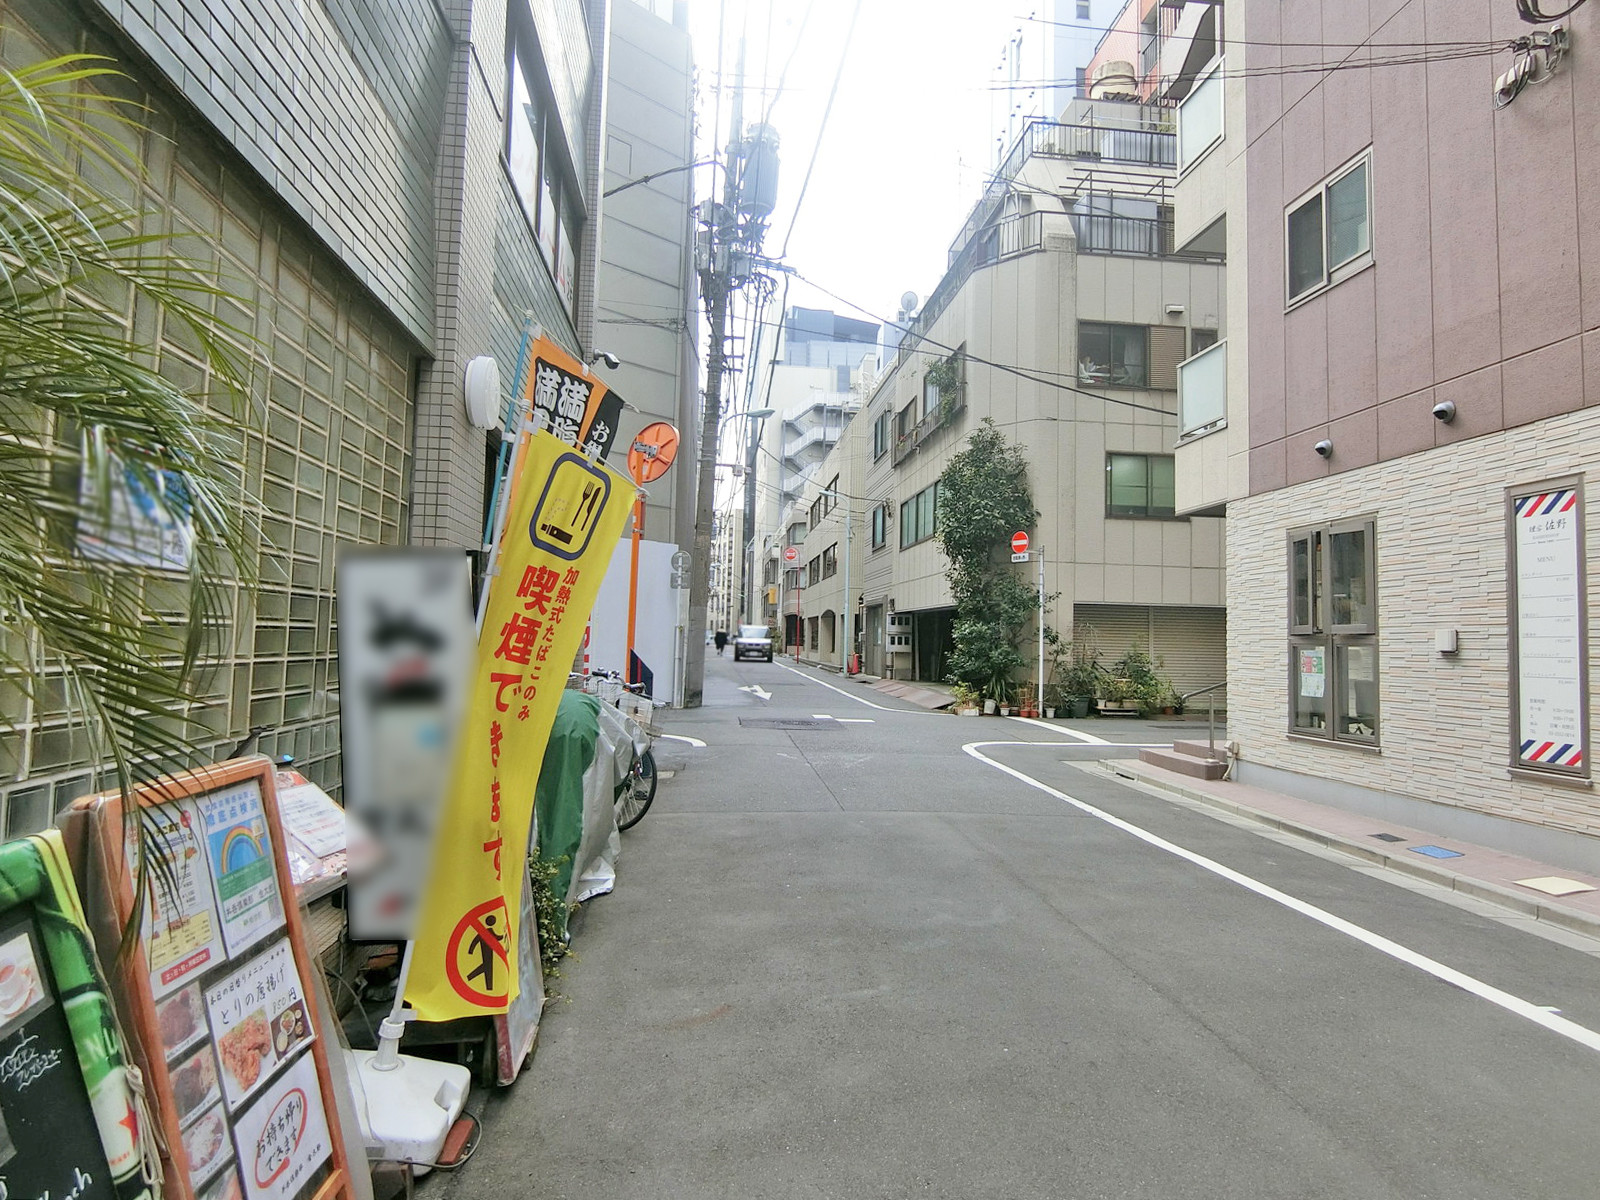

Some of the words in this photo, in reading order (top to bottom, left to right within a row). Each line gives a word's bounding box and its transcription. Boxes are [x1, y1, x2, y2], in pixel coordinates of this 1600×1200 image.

[1546, 518, 1567, 531] 佐野
[1537, 555, 1556, 563] MENU
[518, 566, 578, 721] 加熱式たばこのみ
[221, 963, 285, 1025] とりの唐揚げ
[256, 1095, 303, 1159] お持ち帰り
[265, 1126, 298, 1172] できます
